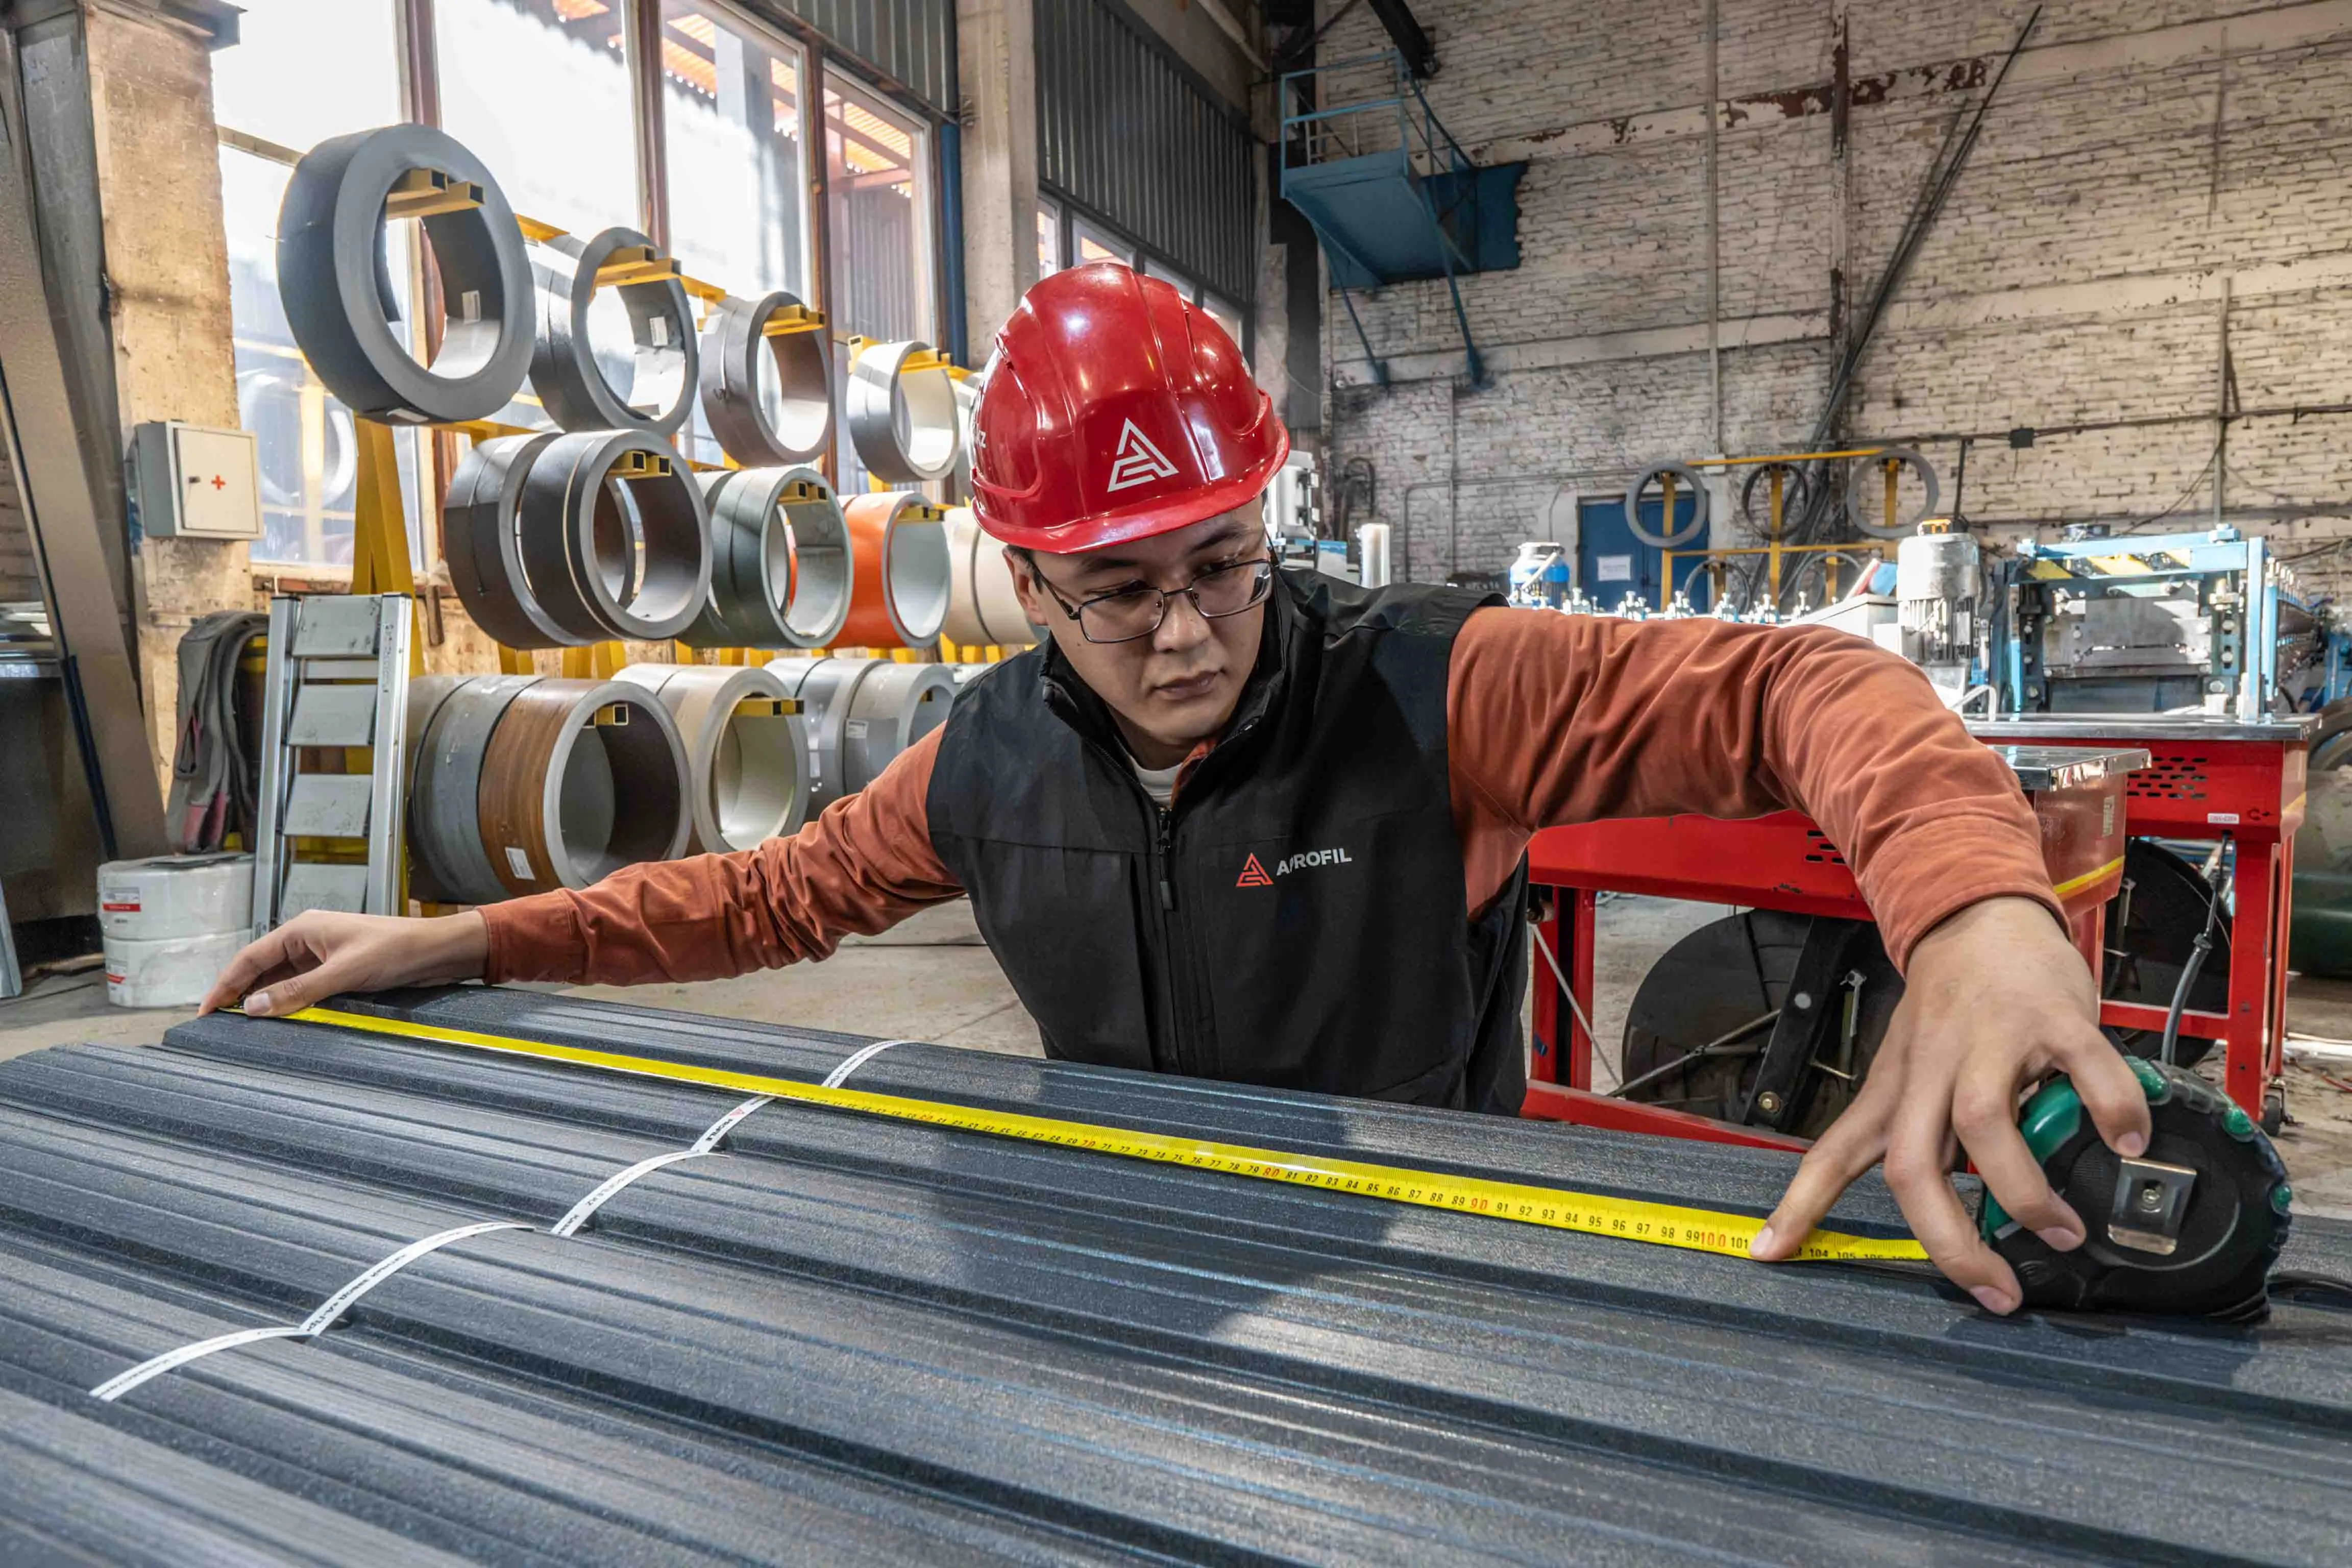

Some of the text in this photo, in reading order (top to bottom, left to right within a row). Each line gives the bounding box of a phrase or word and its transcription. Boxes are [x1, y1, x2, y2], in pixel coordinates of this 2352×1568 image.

[1276, 847, 1352, 876] AROFIL
[1263, 1168, 1280, 1177] 80
[1285, 1171, 1298, 1180] 81
[1305, 1174, 1319, 1183] 82
[1325, 1177, 1338, 1186] 83
[1345, 1180, 1359, 1189] 84
[1366, 1183, 1380, 1192] 85
[1386, 1186, 1401, 1196] 86
[1408, 1189, 1422, 1199] 87
[1430, 1193, 1443, 1203] 88
[1452, 1195, 1465, 1206] 89
[1471, 1197, 1488, 1210] 90
[1496, 1203, 1508, 1213] 91
[1518, 1206, 1532, 1216] 92
[1541, 1209, 1555, 1220] 93
[1564, 1212, 1578, 1223] 94
[1588, 1216, 1602, 1227] 95
[1612, 1219, 1626, 1231] 96
[1636, 1222, 1650, 1234] 97
[1660, 1226, 1675, 1239] 98
[1686, 1230, 1700, 1242] 99
[1700, 1232, 1726, 1247] 100
[1731, 1237, 1748, 1250] 101
[1809, 1248, 1828, 1258] 104
